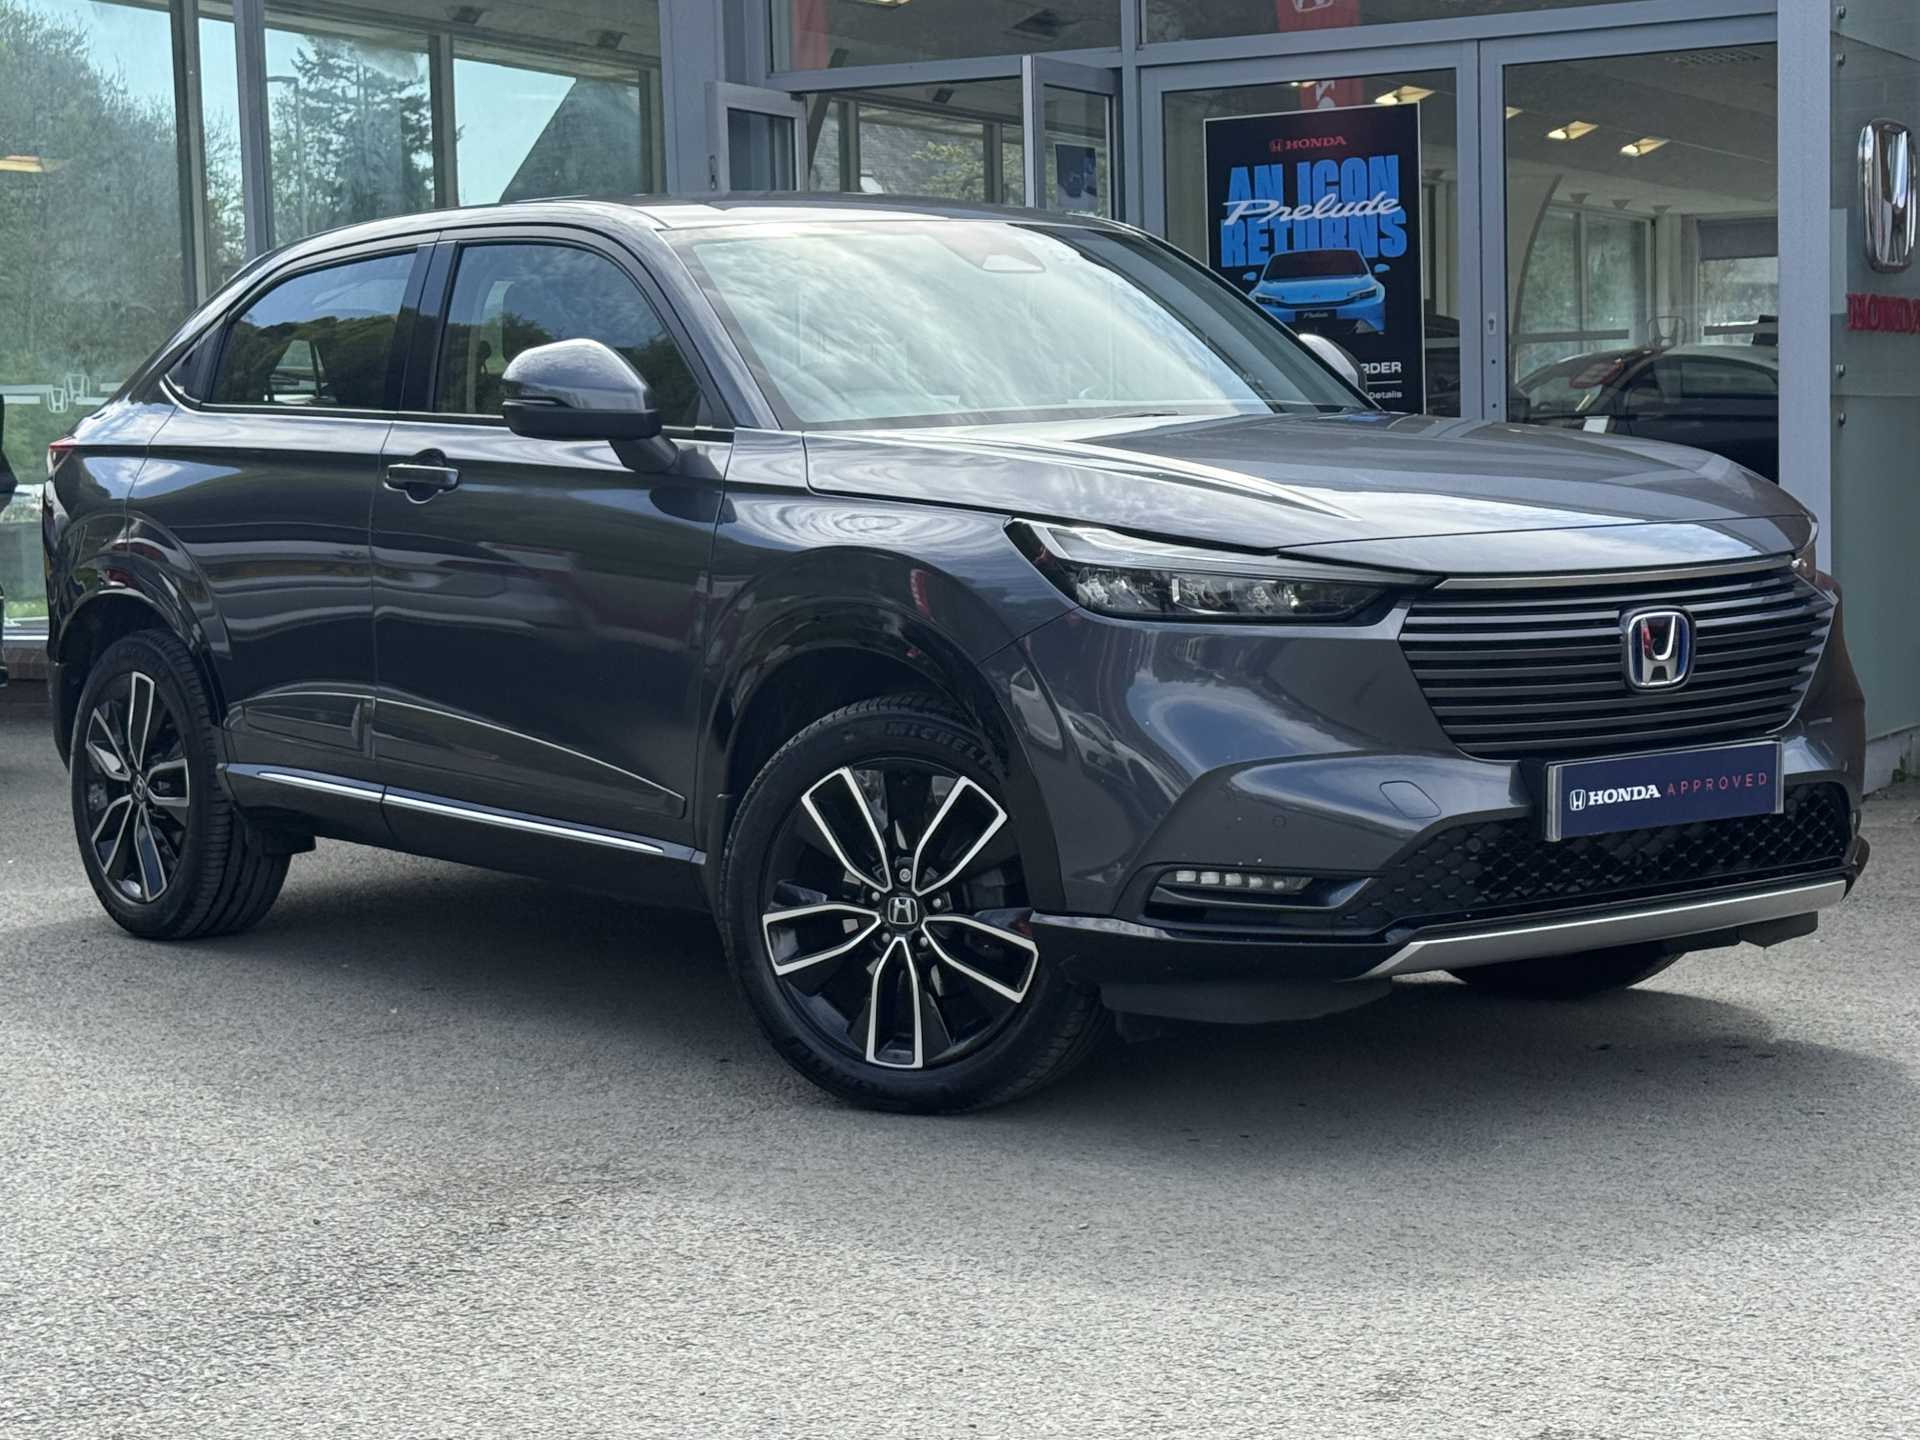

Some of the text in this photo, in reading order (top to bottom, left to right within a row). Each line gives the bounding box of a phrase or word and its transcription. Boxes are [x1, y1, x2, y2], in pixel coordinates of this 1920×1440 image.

[1285, 135, 1347, 150] HONDA
[1226, 154, 1400, 216] AN ICON
[1222, 190, 1402, 226] Prelude
[1220, 208, 1407, 268] RETURNS
[1359, 361, 1402, 374] RDER
[1587, 772, 1767, 806] HONDA APPROVED
